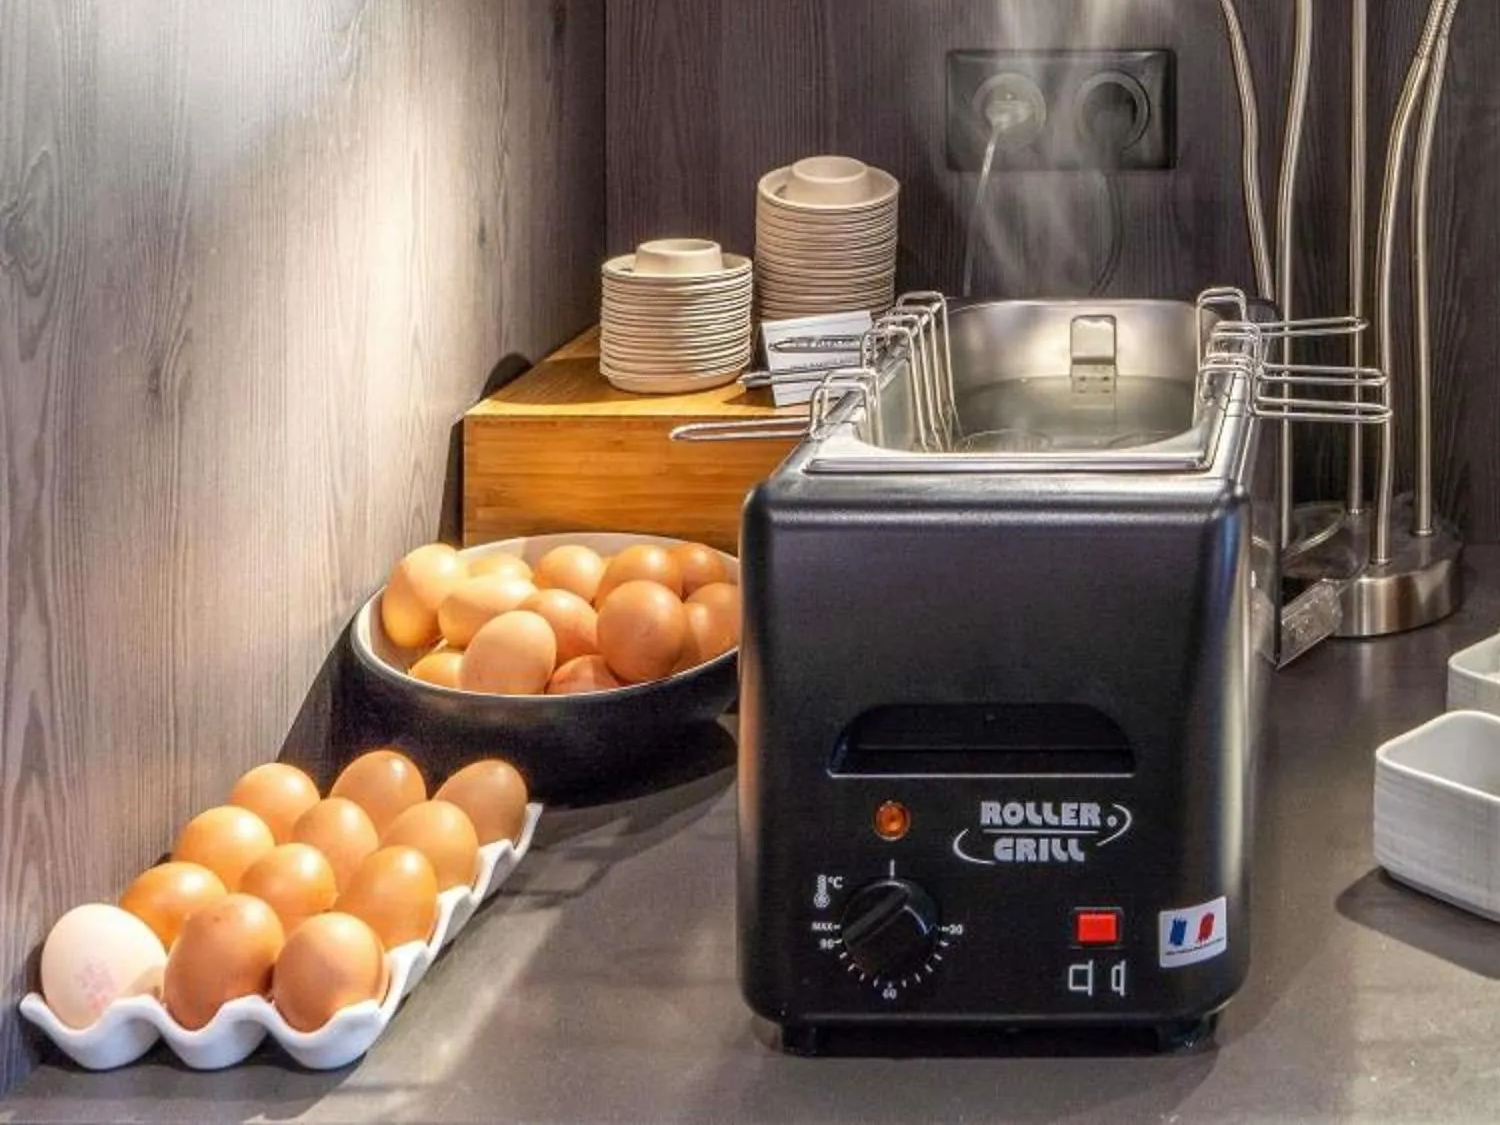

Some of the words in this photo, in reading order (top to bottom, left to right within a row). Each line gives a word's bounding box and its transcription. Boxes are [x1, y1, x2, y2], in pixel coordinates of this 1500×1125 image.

[980, 800, 1101, 826] ROLLER
[993, 836, 1086, 863] GRILL
[811, 921, 833, 932] MAX
